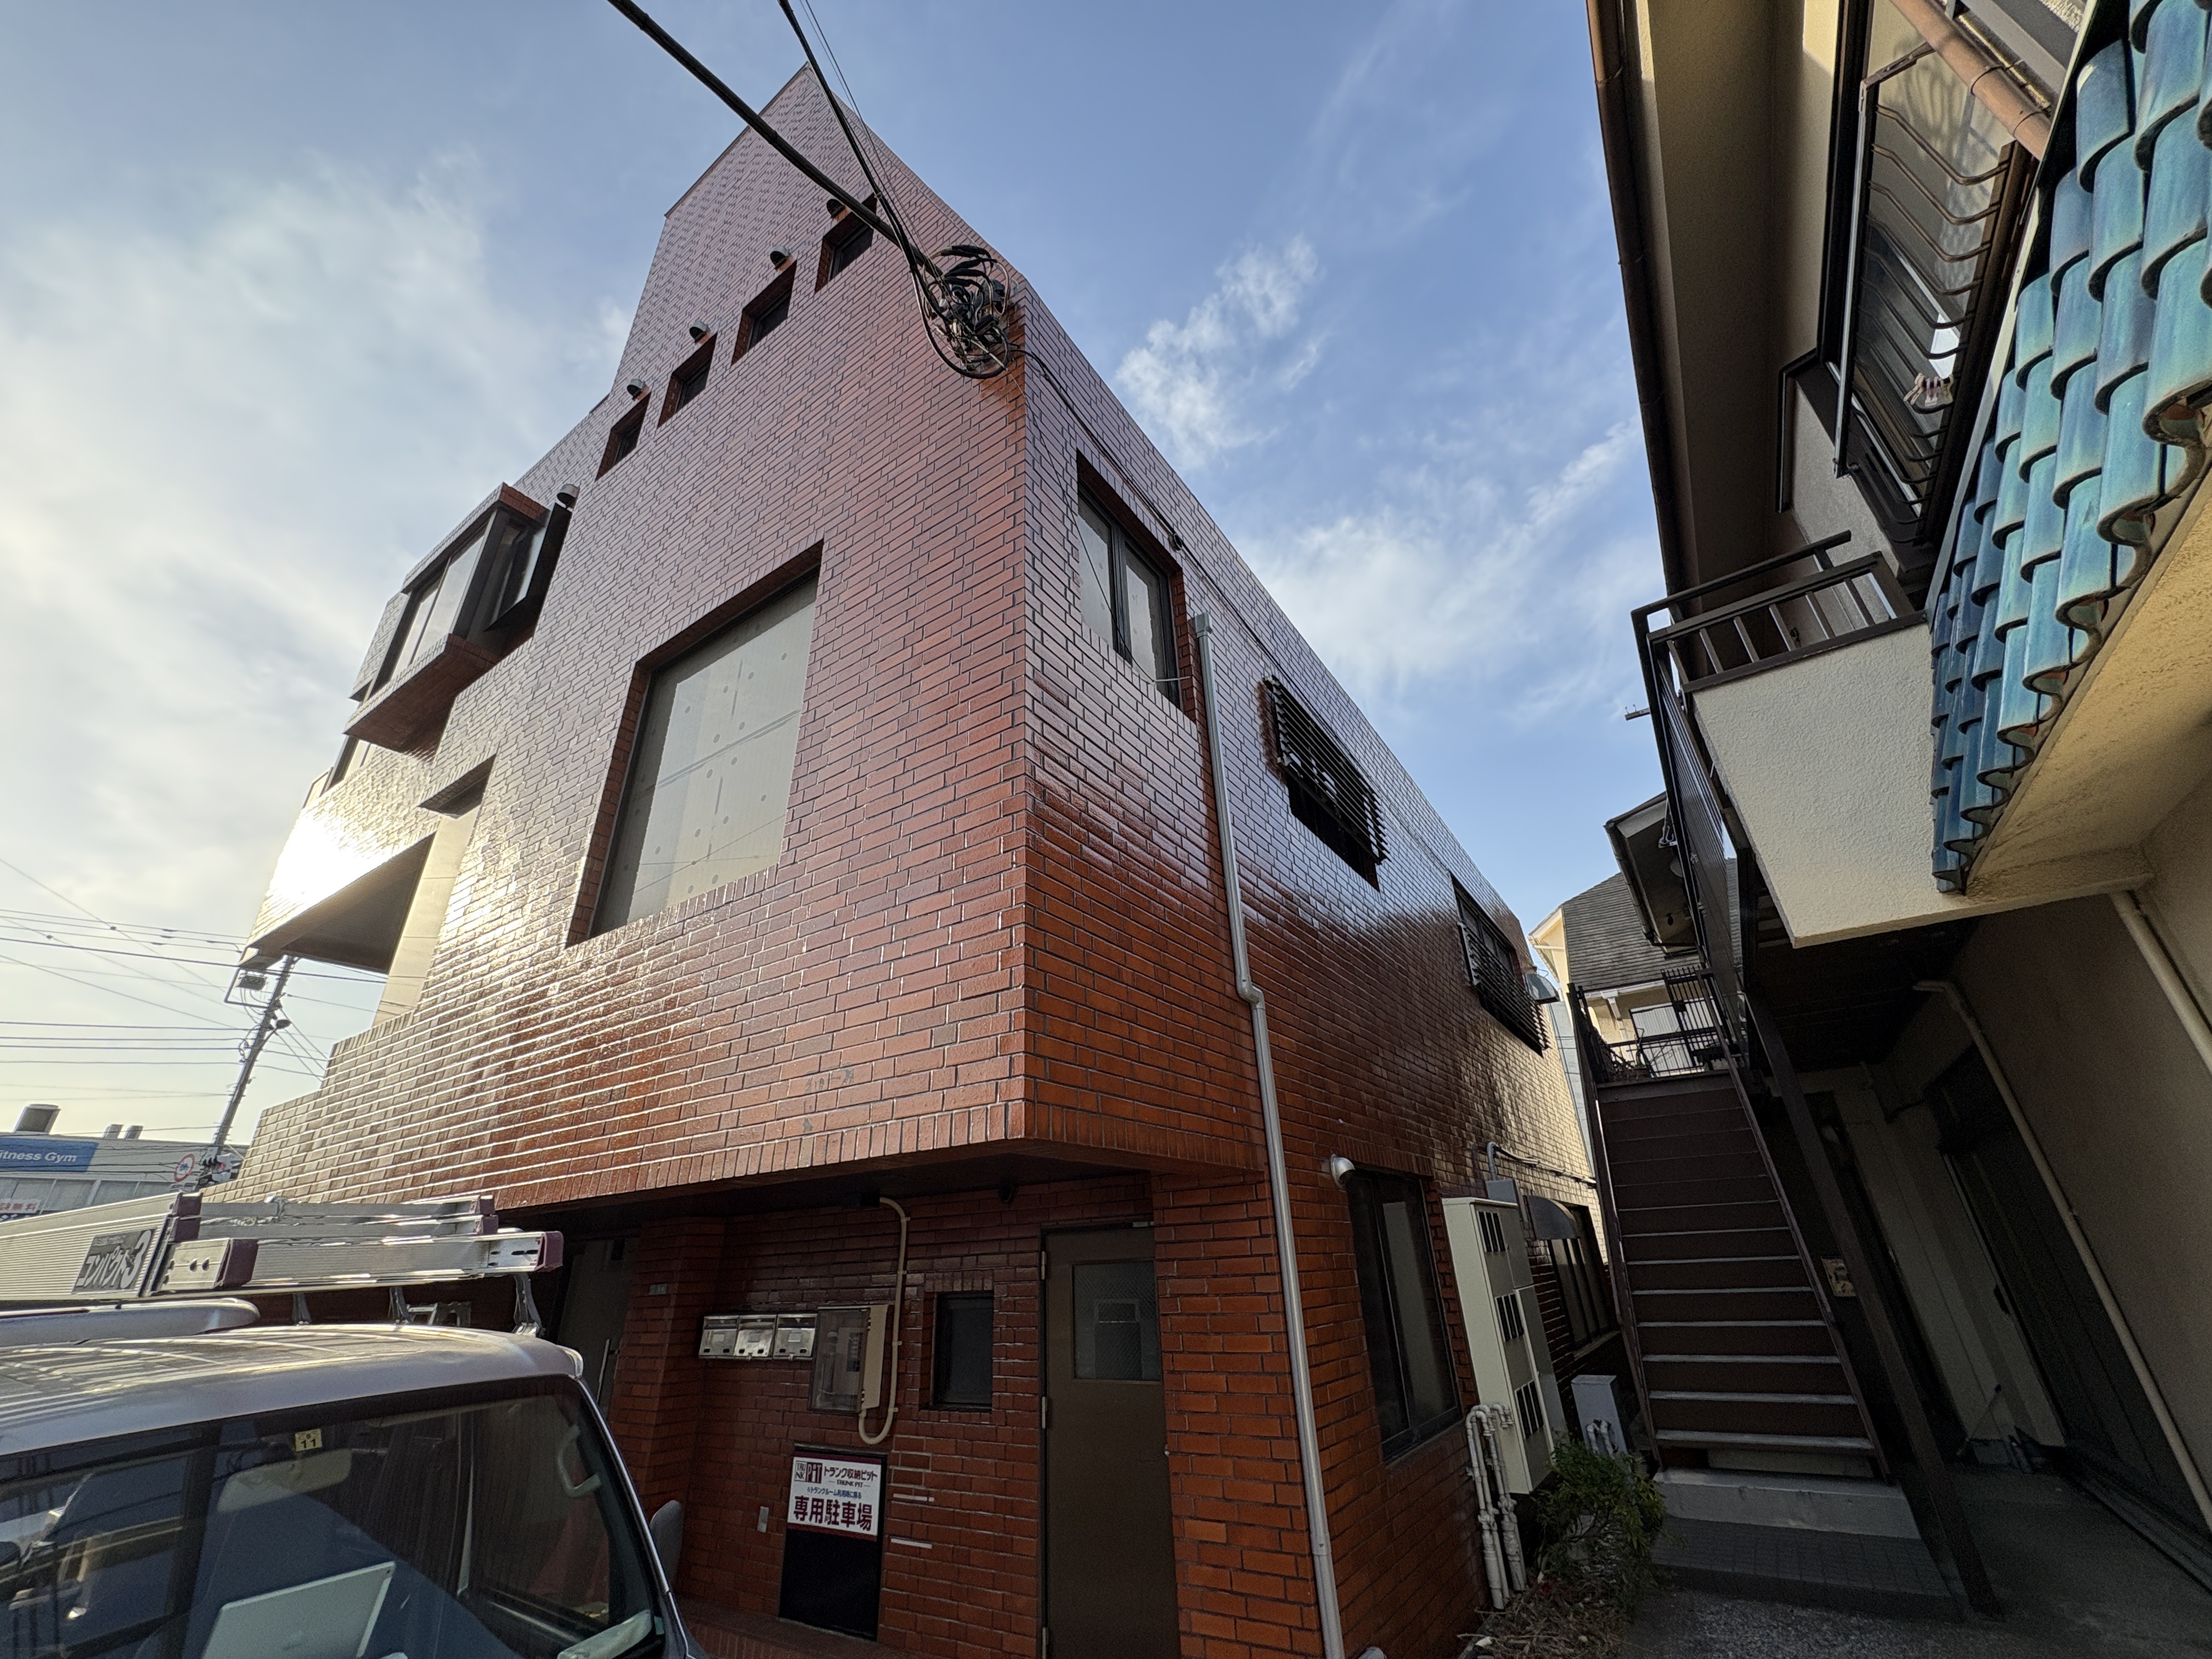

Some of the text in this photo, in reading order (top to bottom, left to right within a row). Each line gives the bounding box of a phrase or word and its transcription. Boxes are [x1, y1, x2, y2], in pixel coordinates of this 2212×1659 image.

[0, 1149, 77, 1164] itness Gym
[301, 1438, 315, 1449] 11
[797, 1463, 806, 1471] TRU
[824, 1466, 878, 1481] トランク収納ピット
[795, 1471, 805, 1480] NK
[793, 1495, 873, 1531] 専用駐車場
